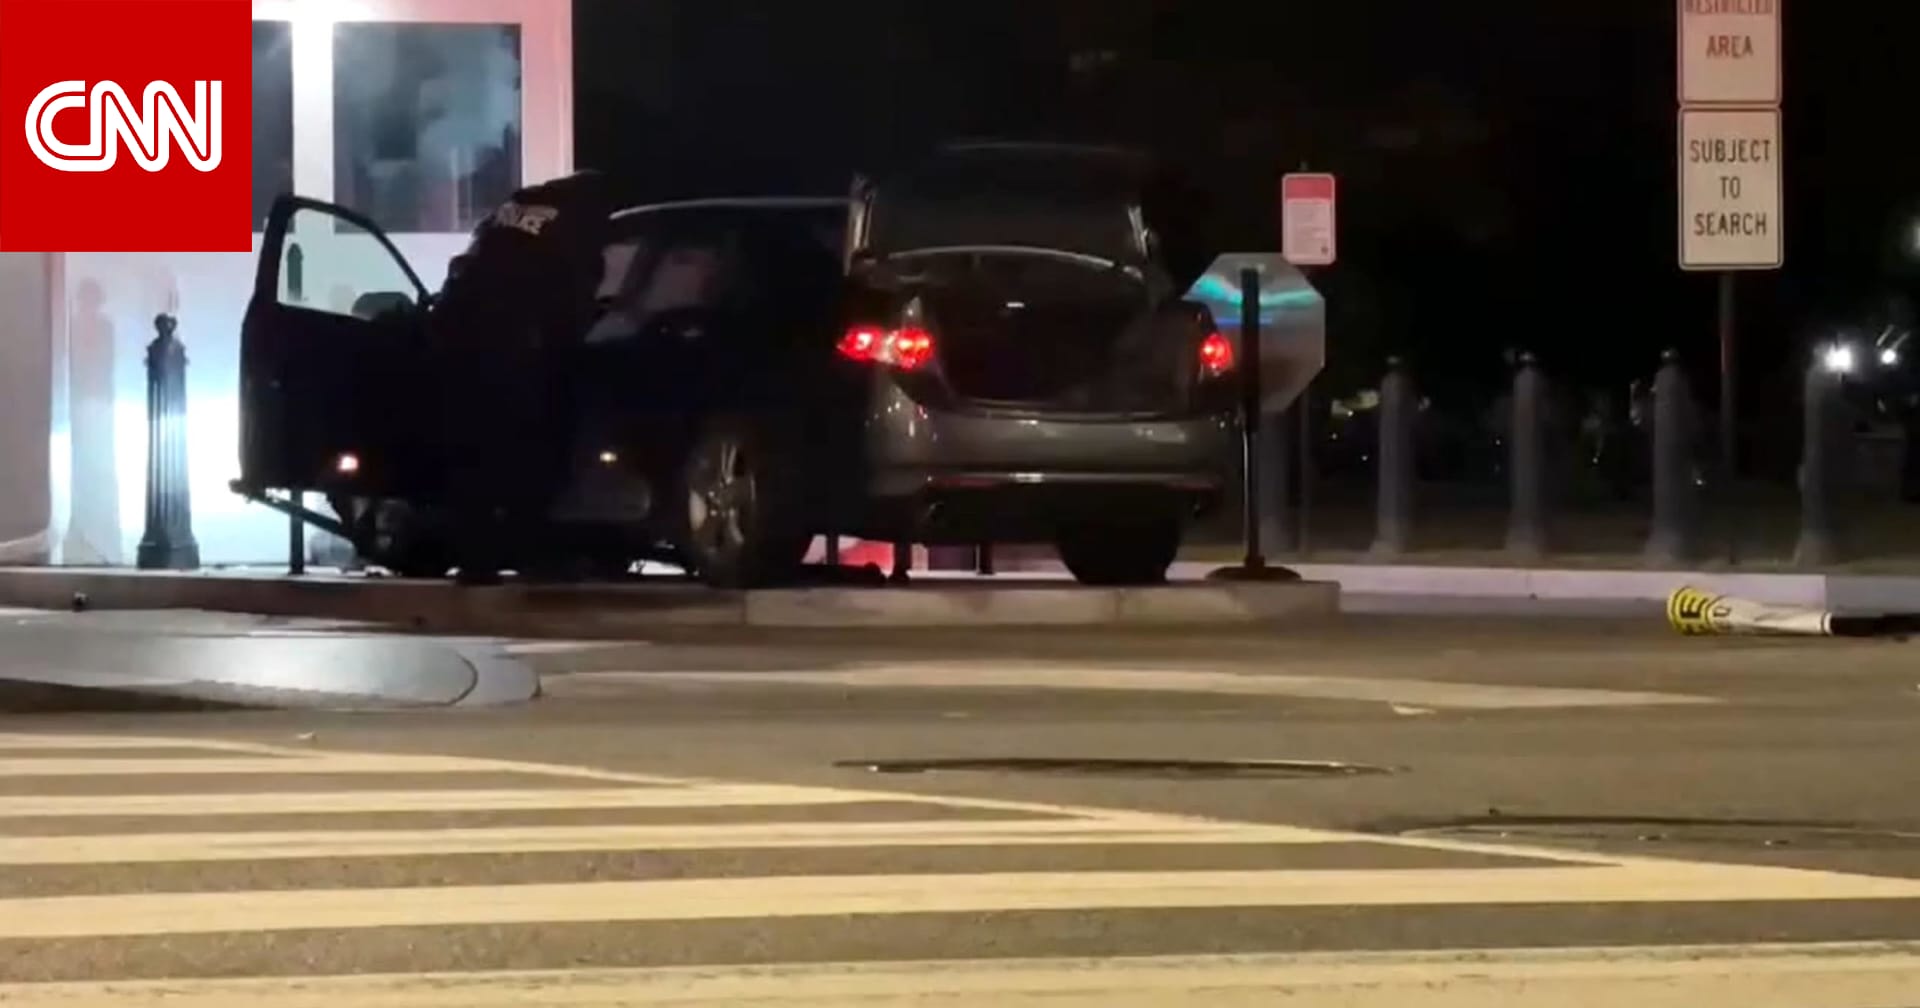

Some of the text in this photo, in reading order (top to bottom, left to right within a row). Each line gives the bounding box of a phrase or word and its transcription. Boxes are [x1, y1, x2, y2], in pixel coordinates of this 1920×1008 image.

[1705, 35, 1754, 59] AREA
[1689, 139, 1771, 163] SUBJECT
[1720, 175, 1741, 199] TO
[1693, 212, 1768, 236] SEARCH
